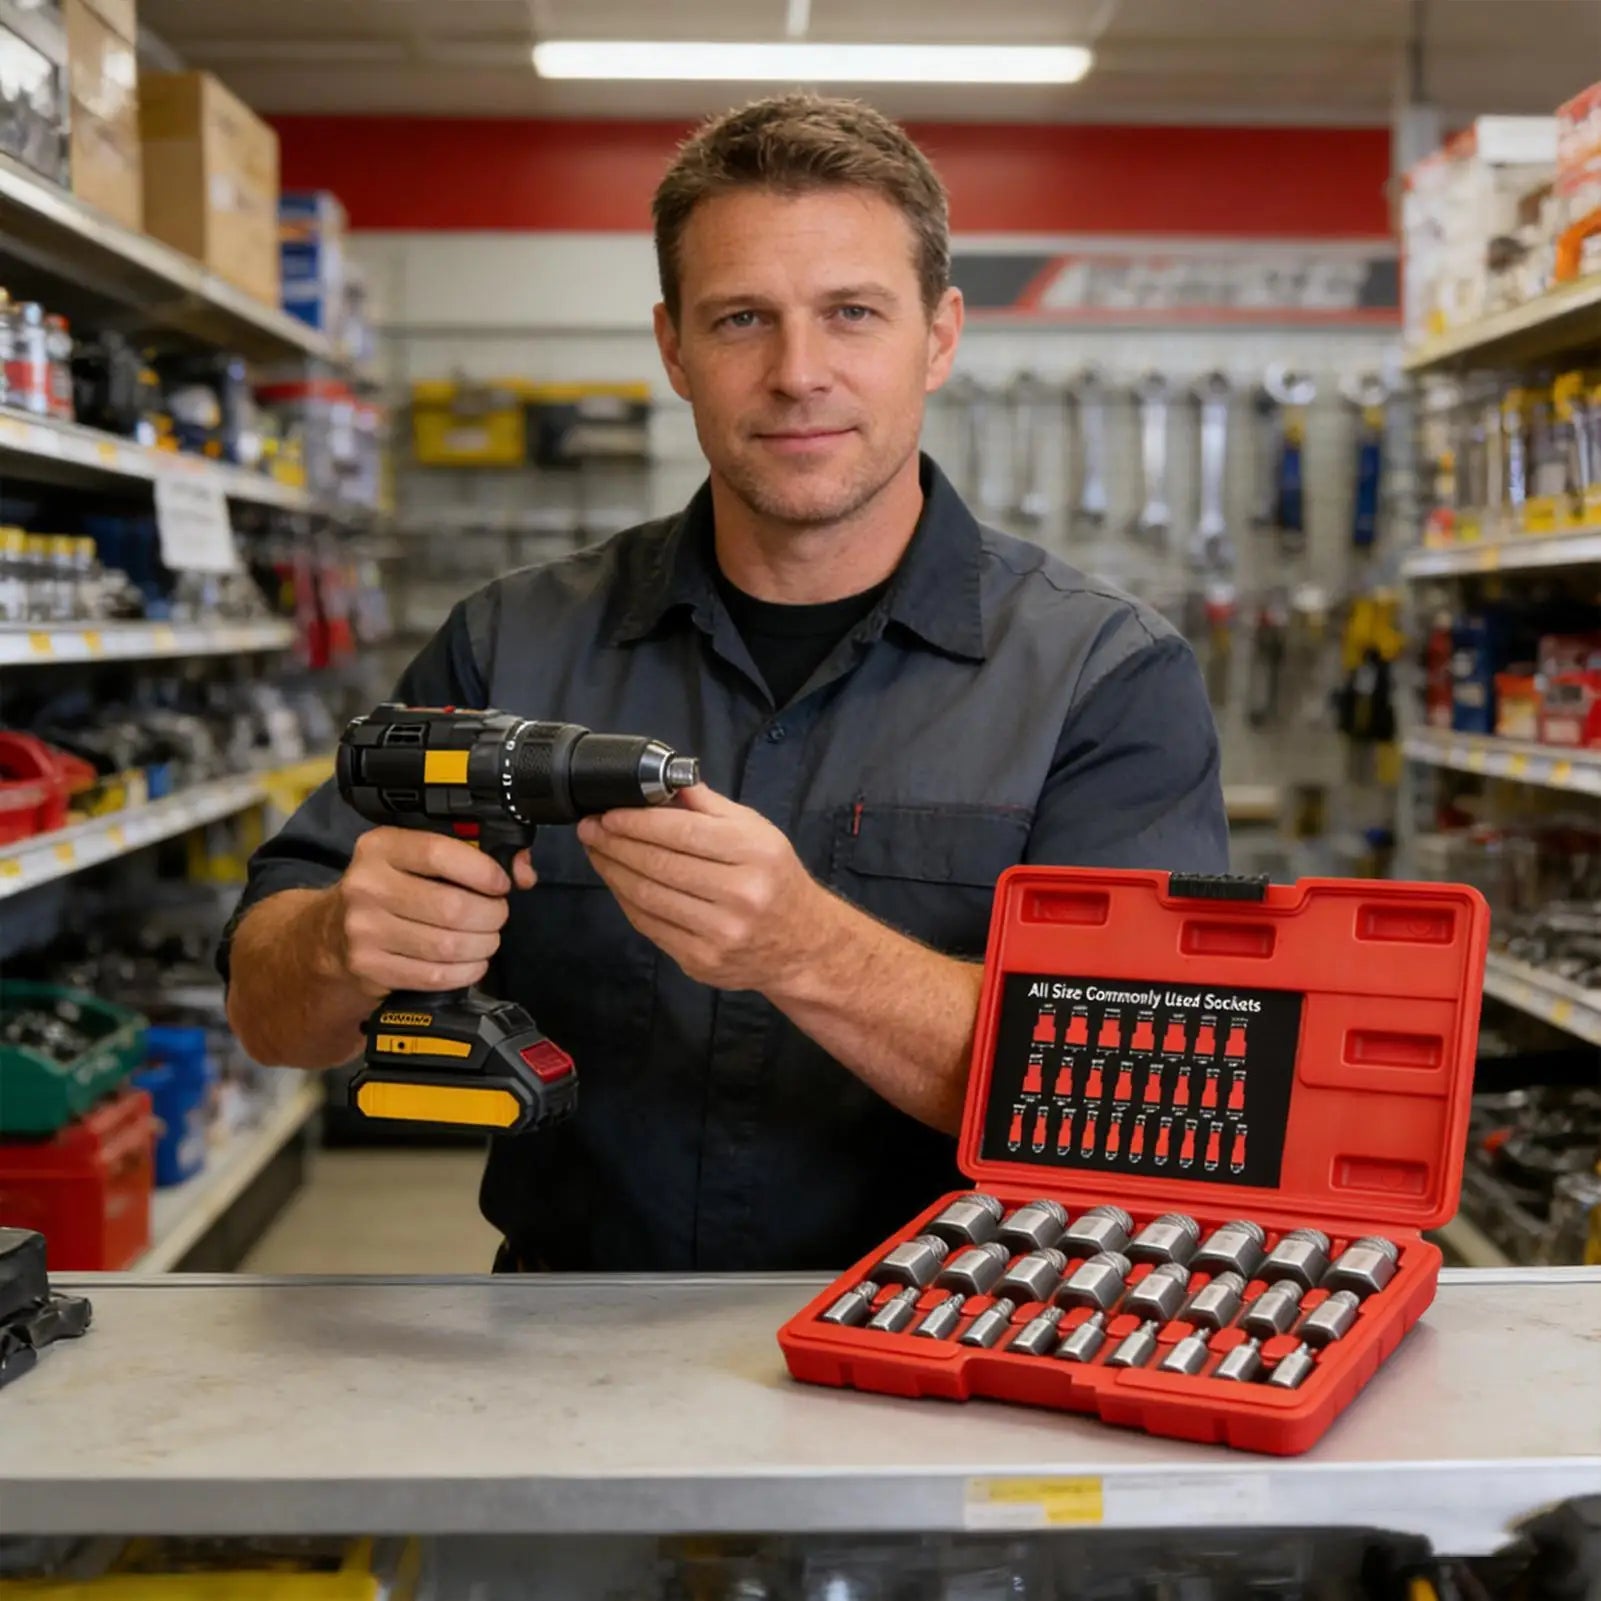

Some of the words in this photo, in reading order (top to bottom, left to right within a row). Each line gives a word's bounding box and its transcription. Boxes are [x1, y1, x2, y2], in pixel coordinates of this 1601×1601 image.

[1028, 982, 1049, 998] All
[1052, 983, 1082, 1000] Size
[1086, 986, 1162, 1009] Commonly
